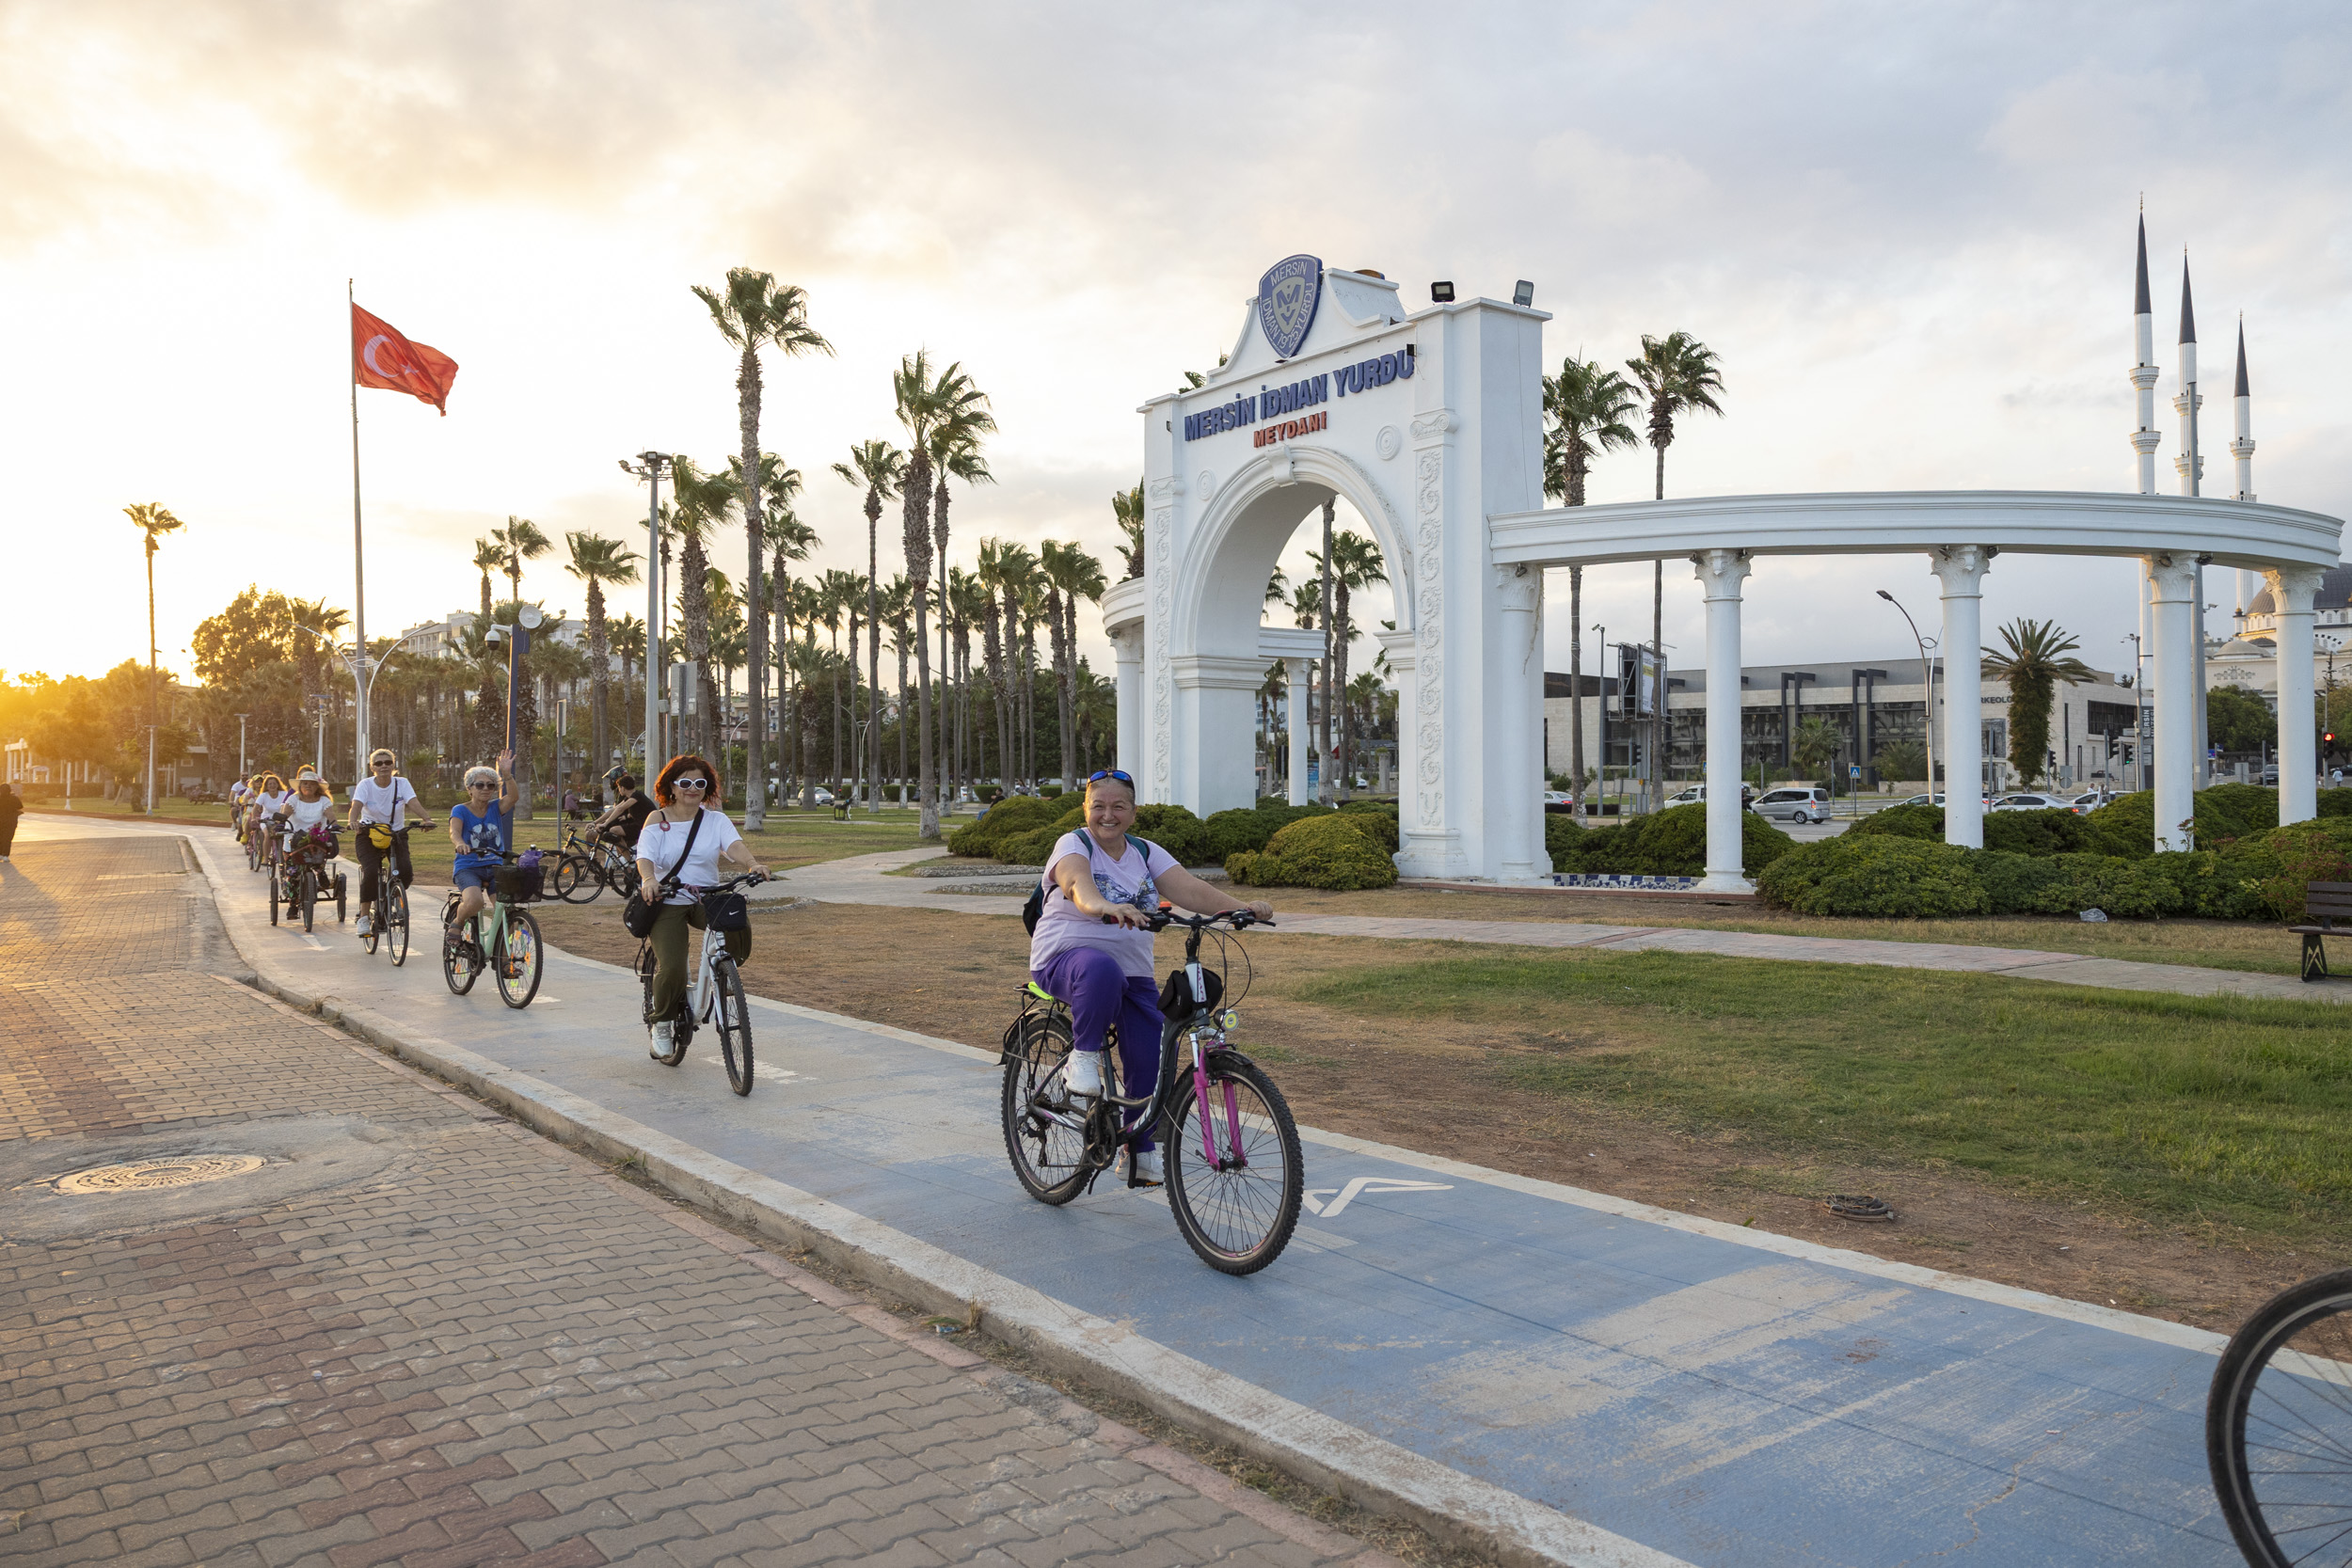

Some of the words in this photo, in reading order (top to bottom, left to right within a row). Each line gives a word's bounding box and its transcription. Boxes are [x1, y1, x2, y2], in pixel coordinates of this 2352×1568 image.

[1295, 283, 1314, 329] YURDU
[1277, 330, 1299, 350] 1925
[1184, 393, 1256, 441] MERSİN
[1260, 373, 1327, 420] İDMAN
[1332, 349, 1414, 397] YURDU
[1253, 410, 1327, 449] MEYDANI
